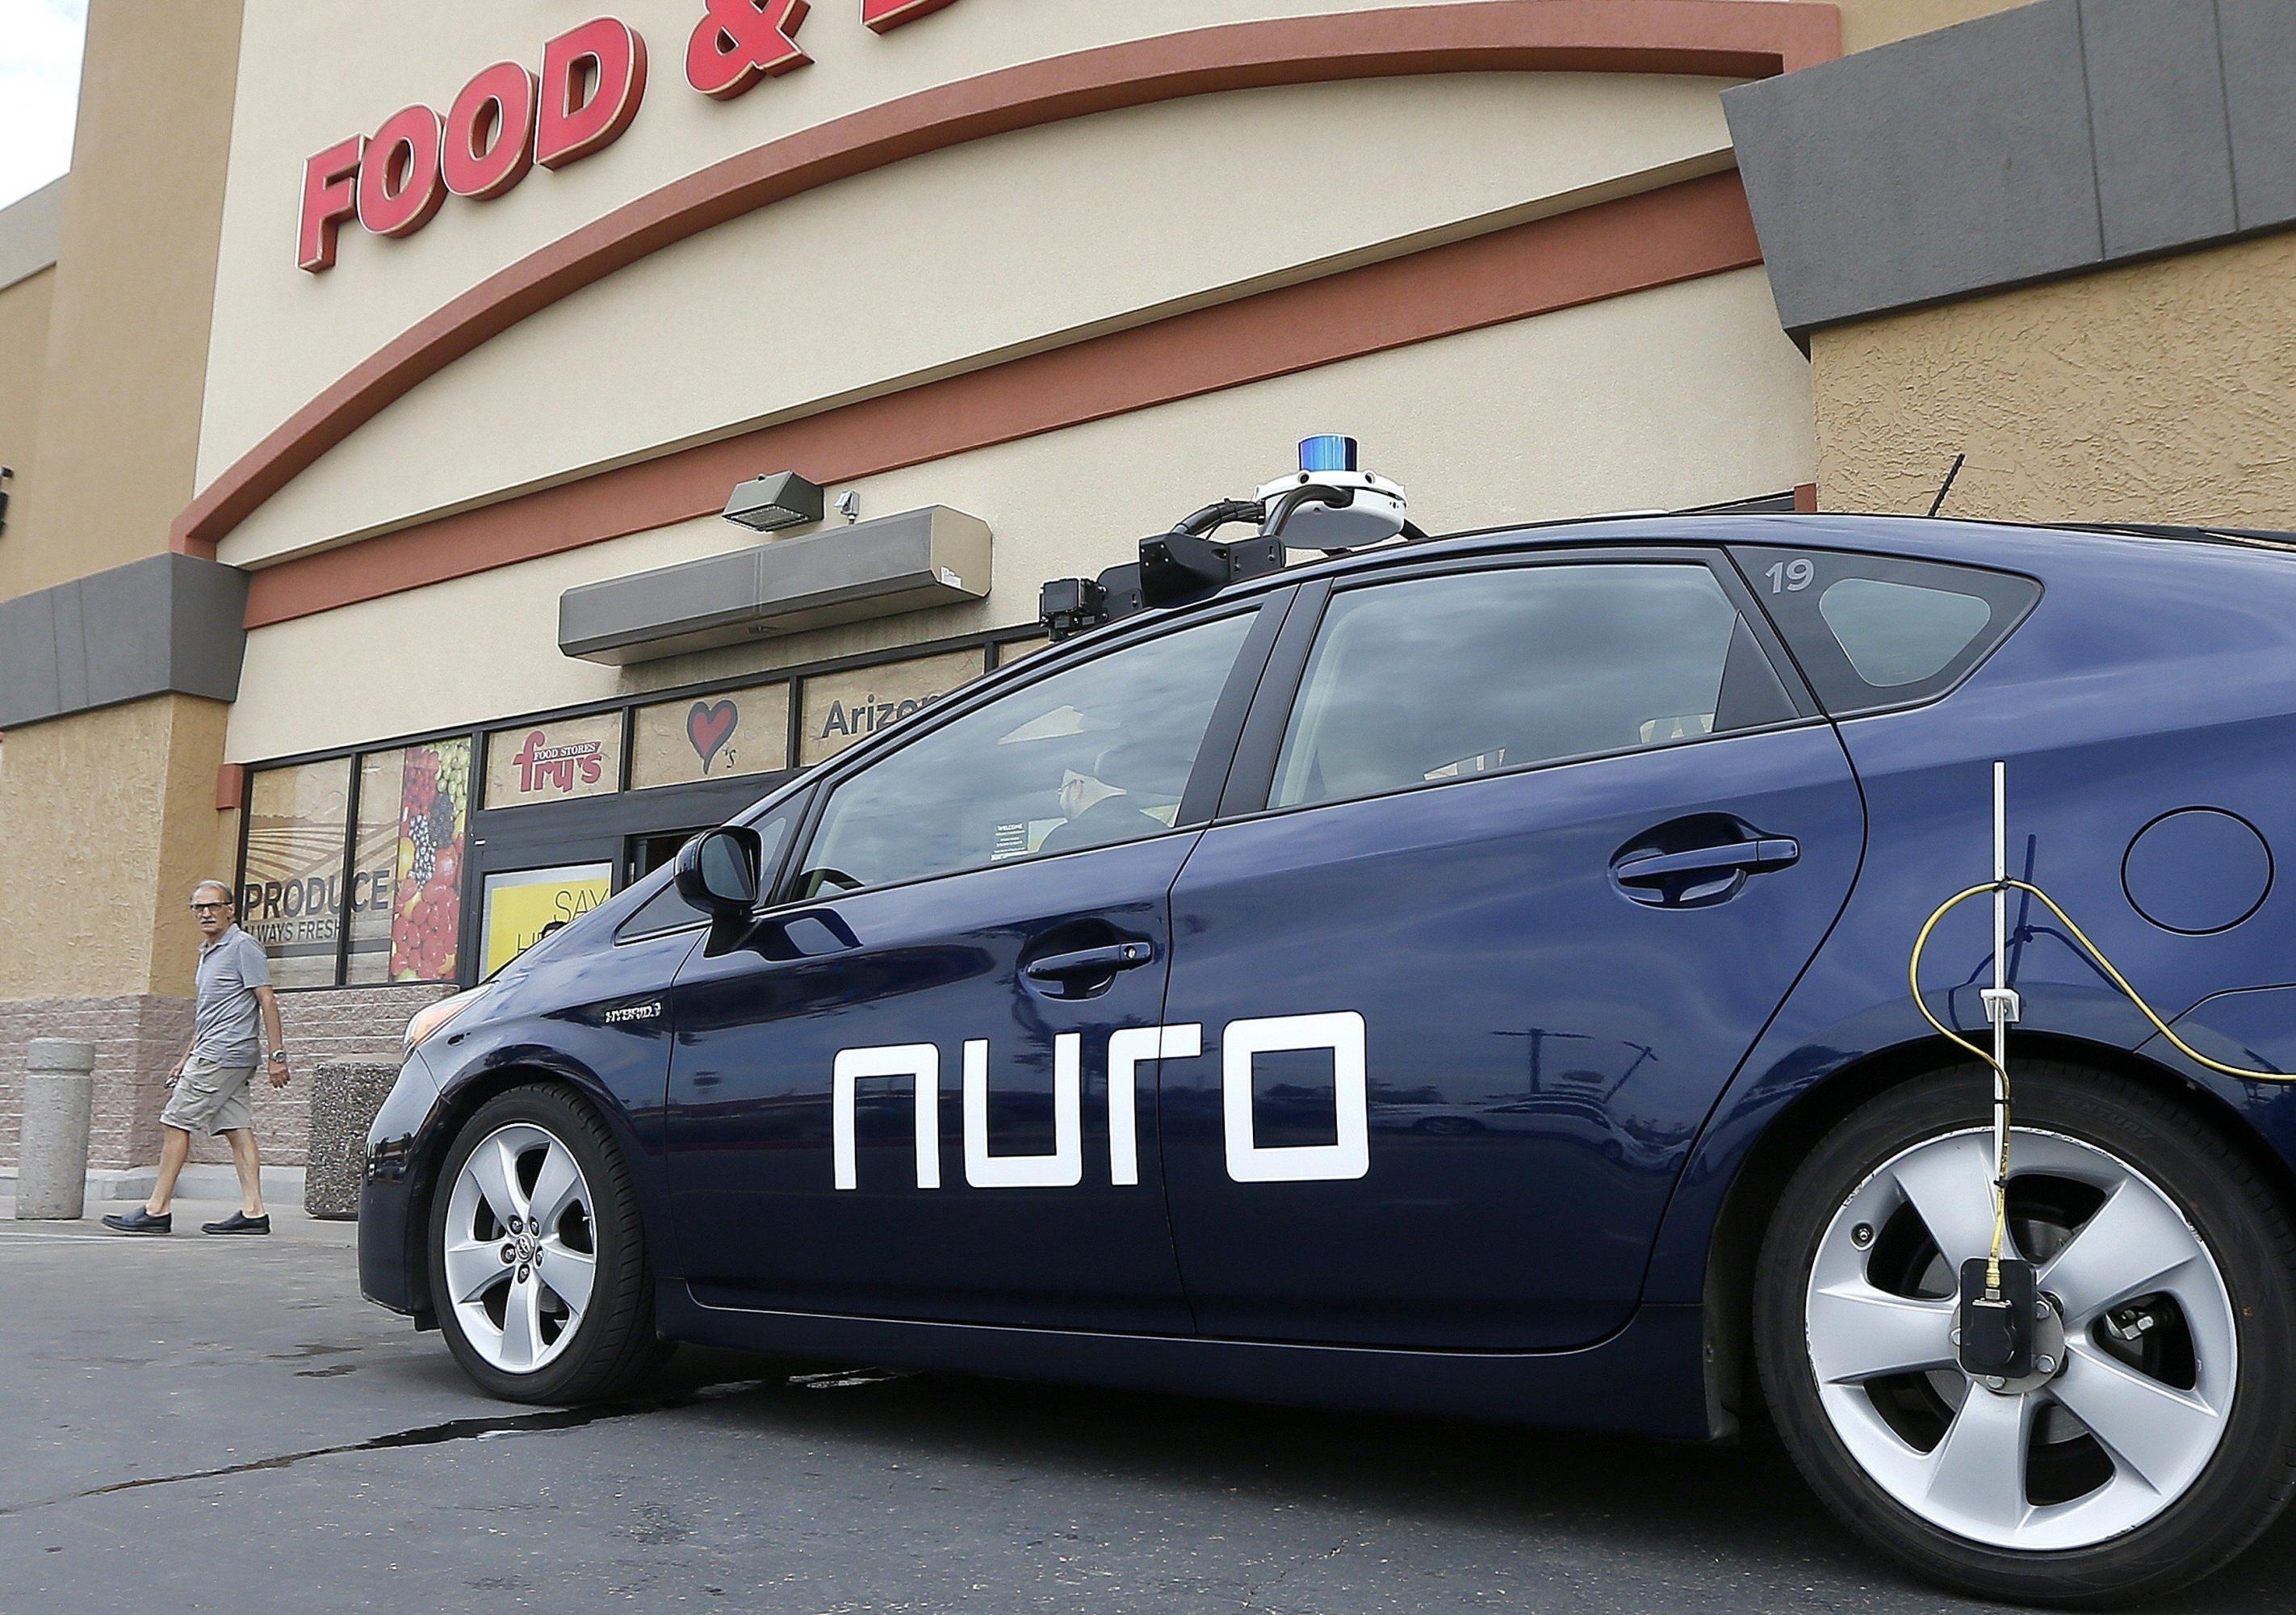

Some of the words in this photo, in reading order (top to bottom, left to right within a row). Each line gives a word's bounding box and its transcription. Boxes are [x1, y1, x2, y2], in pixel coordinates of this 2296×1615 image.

[295, 15, 647, 273] FOOD
[1765, 558, 1815, 594] 19
[822, 694, 941, 738] Arizo
[513, 730, 602, 792] fry's
[534, 748, 559, 761] FOOD
[560, 742, 596, 757] STORES
[243, 869, 390, 921] PRODUCE
[832, 1010, 1370, 1190] nuro
